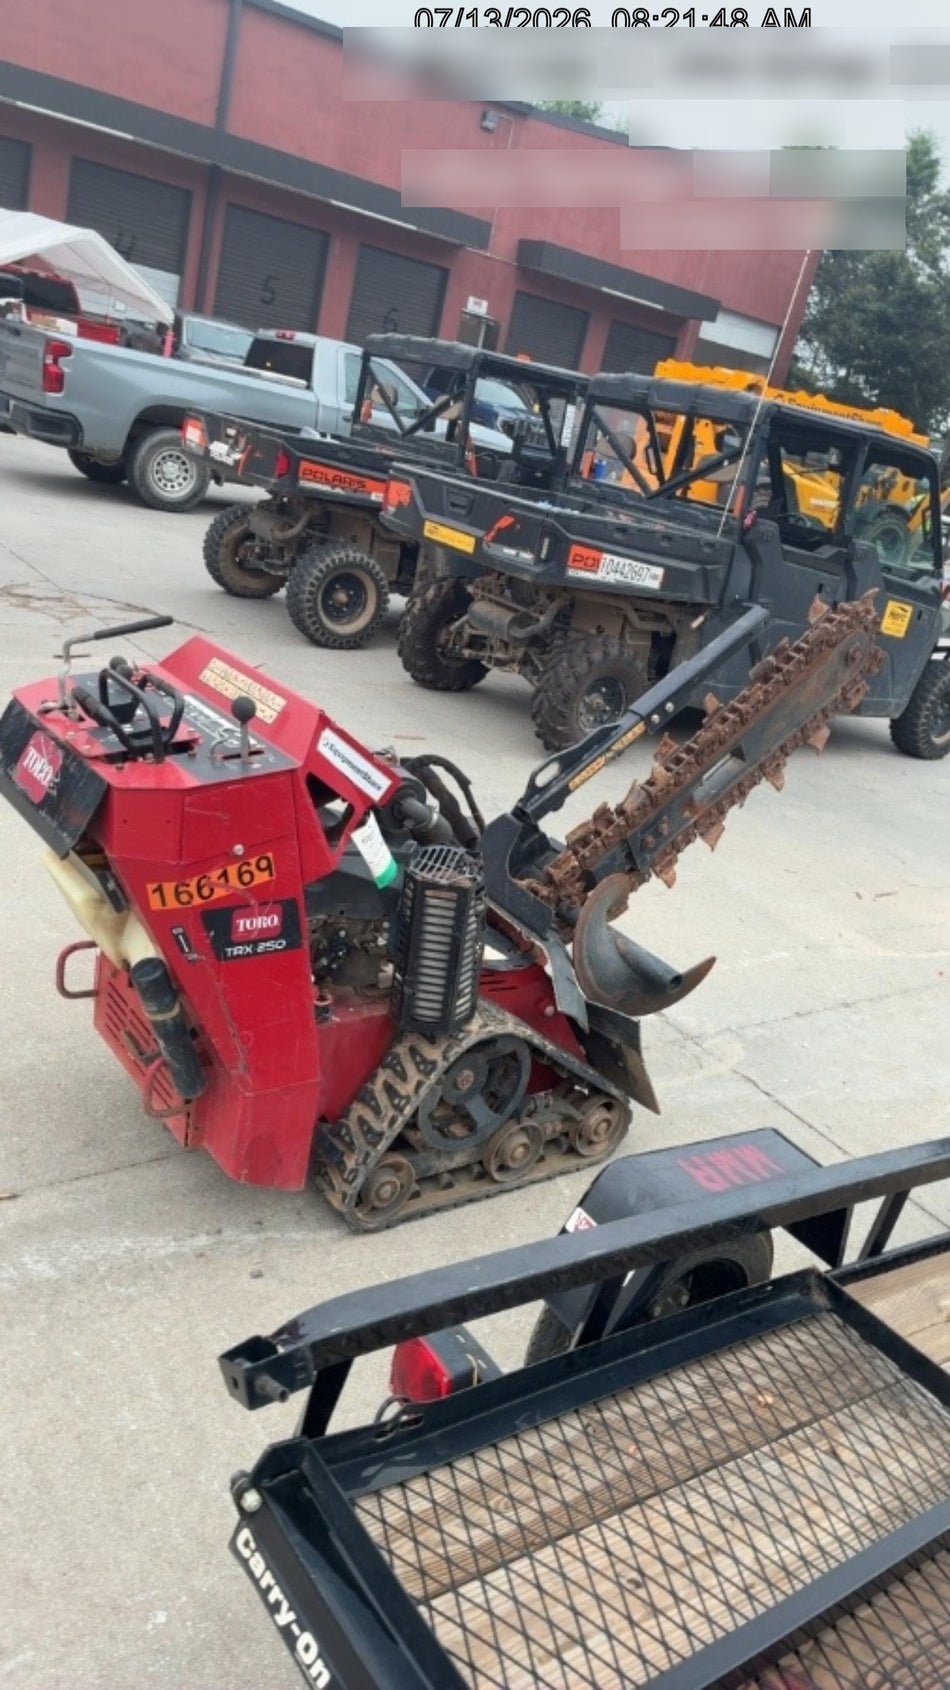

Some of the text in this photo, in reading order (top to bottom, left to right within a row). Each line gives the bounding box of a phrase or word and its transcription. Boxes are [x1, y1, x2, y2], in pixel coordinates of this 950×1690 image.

[261, 275, 279, 305] 5
[382, 307, 398, 331] 6
[302, 467, 367, 492] POLARIS
[22, 746, 55, 788] TORO
[151, 855, 273, 907] 166169
[236, 914, 281, 932] TORO
[225, 939, 287, 957] TRX 250
[236, 1527, 331, 1690] Carry-On
